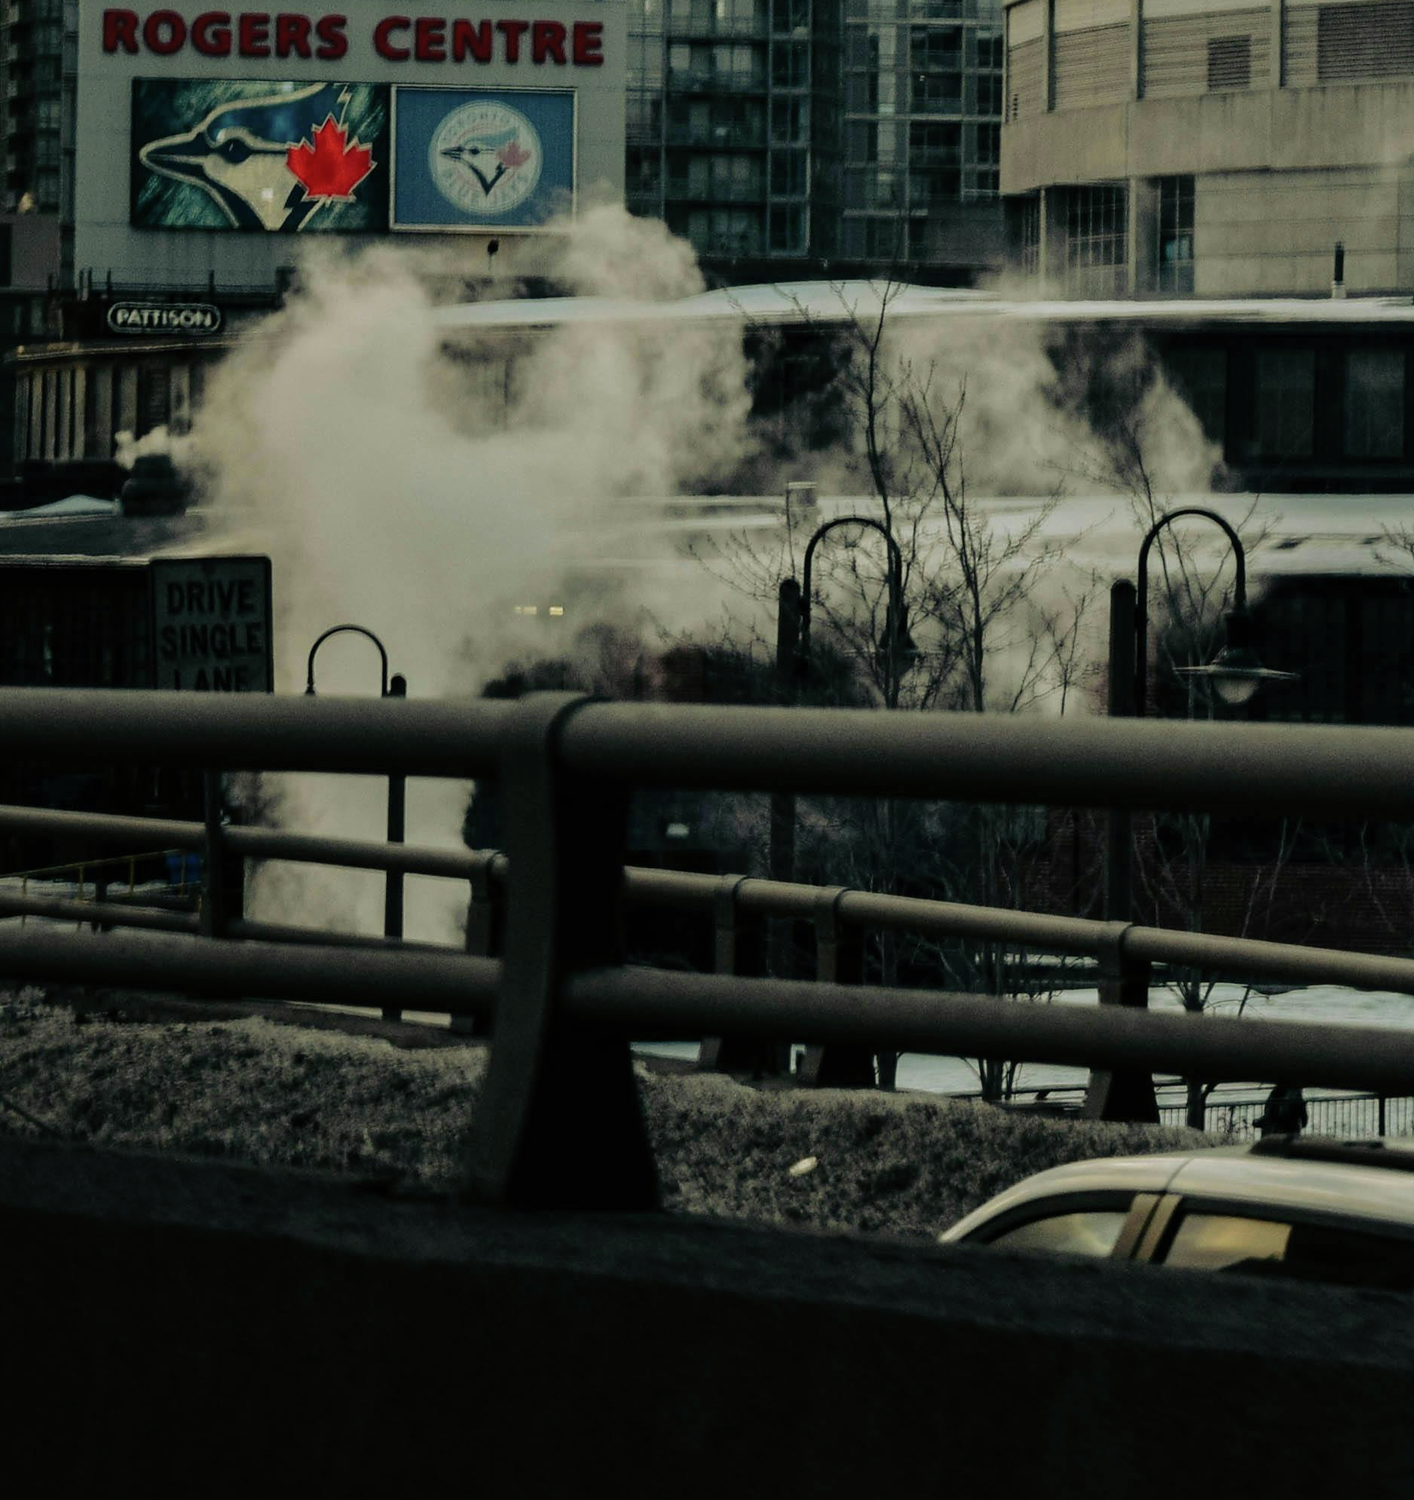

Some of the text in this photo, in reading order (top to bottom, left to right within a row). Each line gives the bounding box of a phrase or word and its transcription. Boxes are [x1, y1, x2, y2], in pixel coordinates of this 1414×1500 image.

[102, 8, 605, 66] ROGERS CENTRE
[116, 308, 212, 328] PATTISON
[167, 580, 255, 615] DRIVE
[161, 622, 263, 659] SINGLE
[174, 664, 250, 692] LANE
